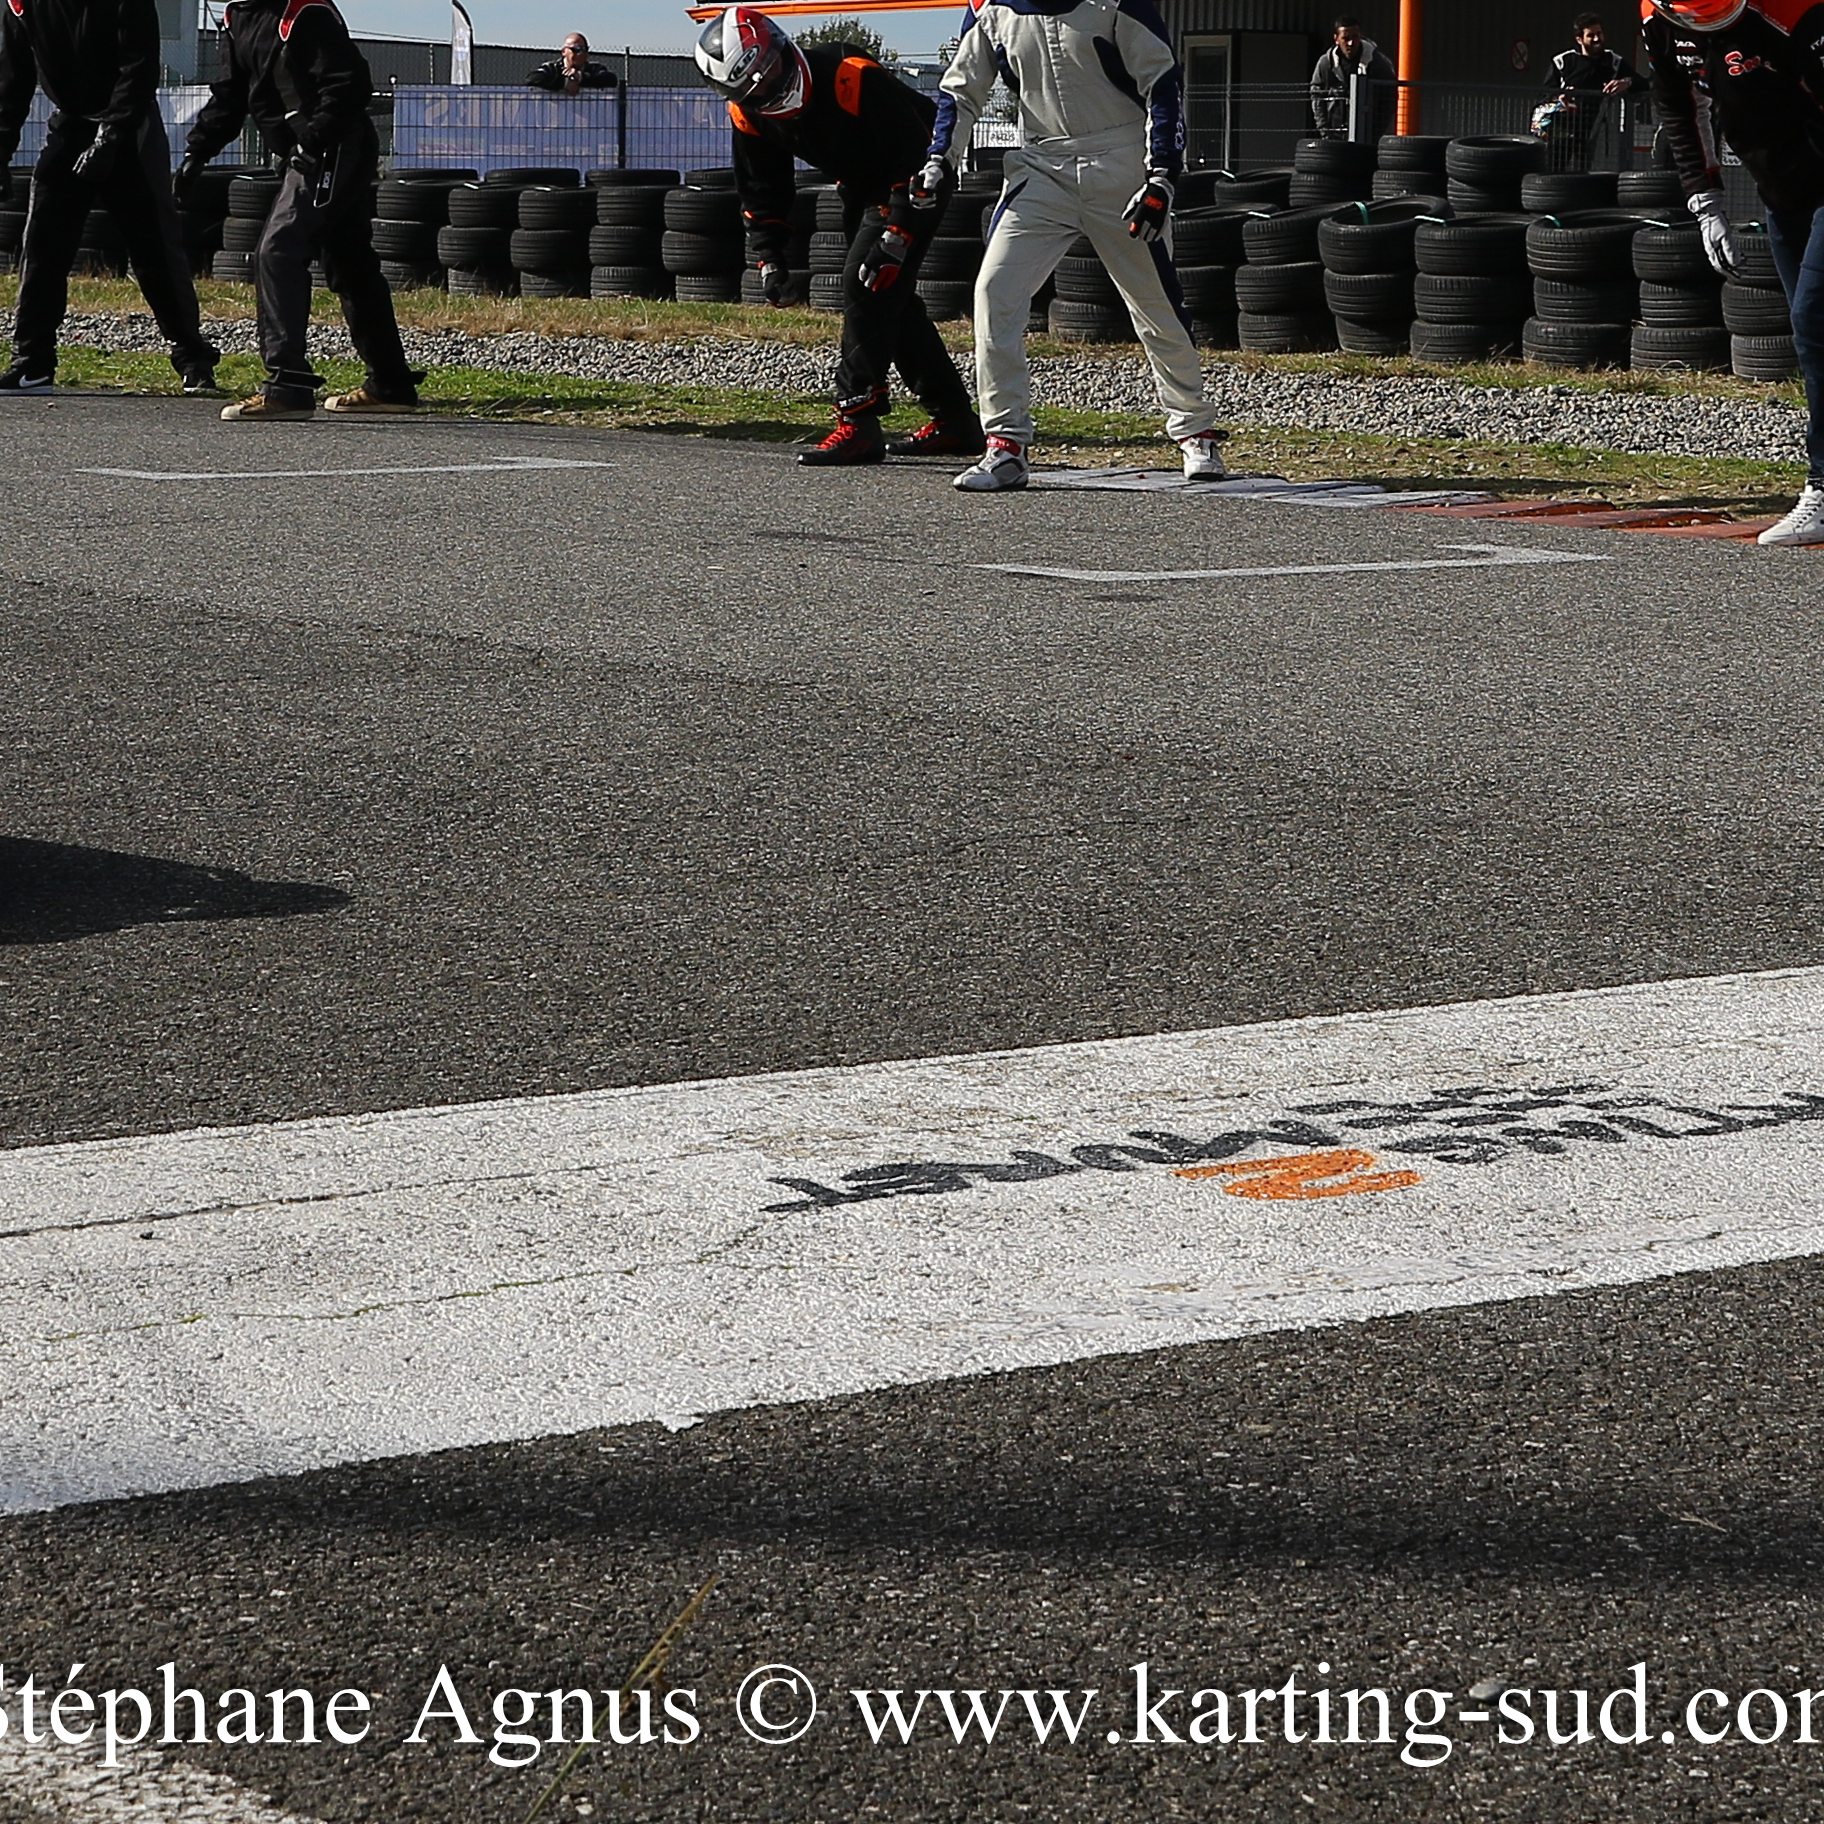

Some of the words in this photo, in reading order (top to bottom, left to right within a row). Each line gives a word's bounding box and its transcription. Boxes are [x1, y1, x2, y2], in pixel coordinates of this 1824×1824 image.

[731, 45, 760, 81] HJC
[760, 1119, 1342, 1213] MURET
[1172, 1148, 1423, 1200] 2
